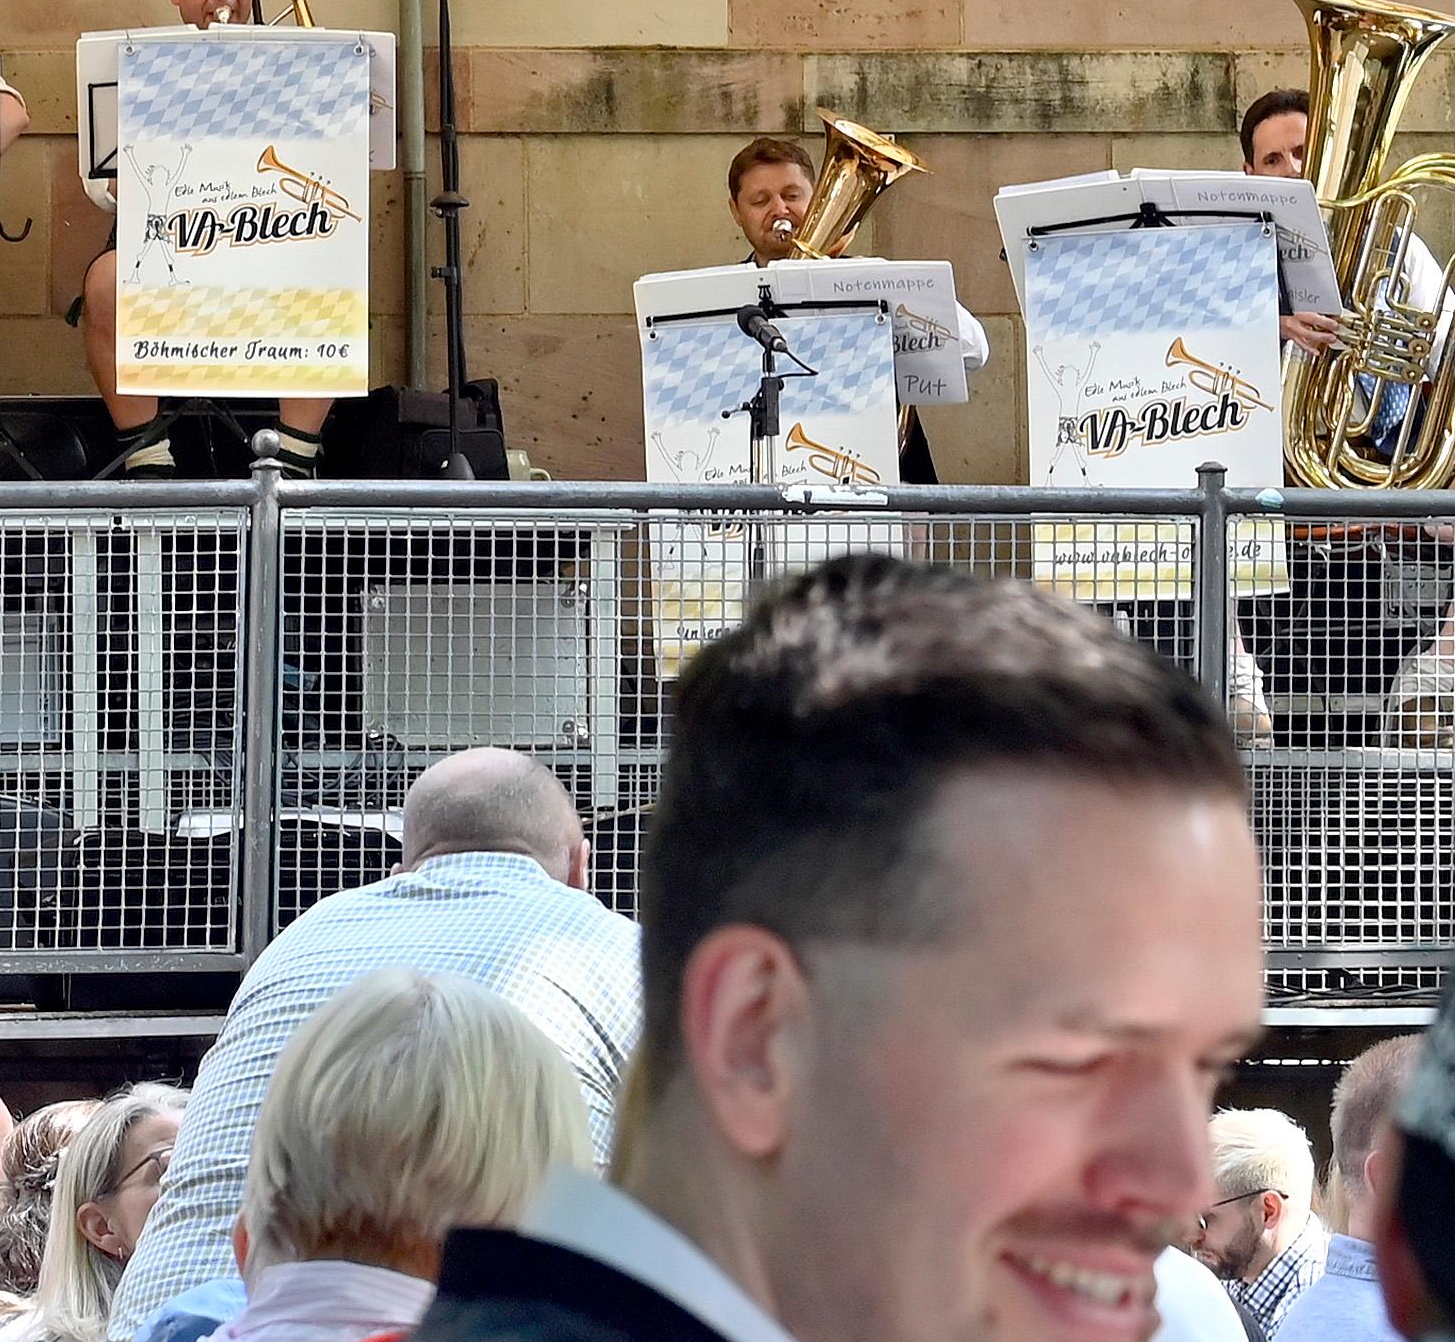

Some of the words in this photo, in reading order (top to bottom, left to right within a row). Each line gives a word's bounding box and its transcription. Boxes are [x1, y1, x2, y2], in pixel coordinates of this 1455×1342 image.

[1196, 190, 1298, 206] Notenmappe
[833, 277, 935, 294] Notenmappe
[316, 343, 350, 359] 10€
